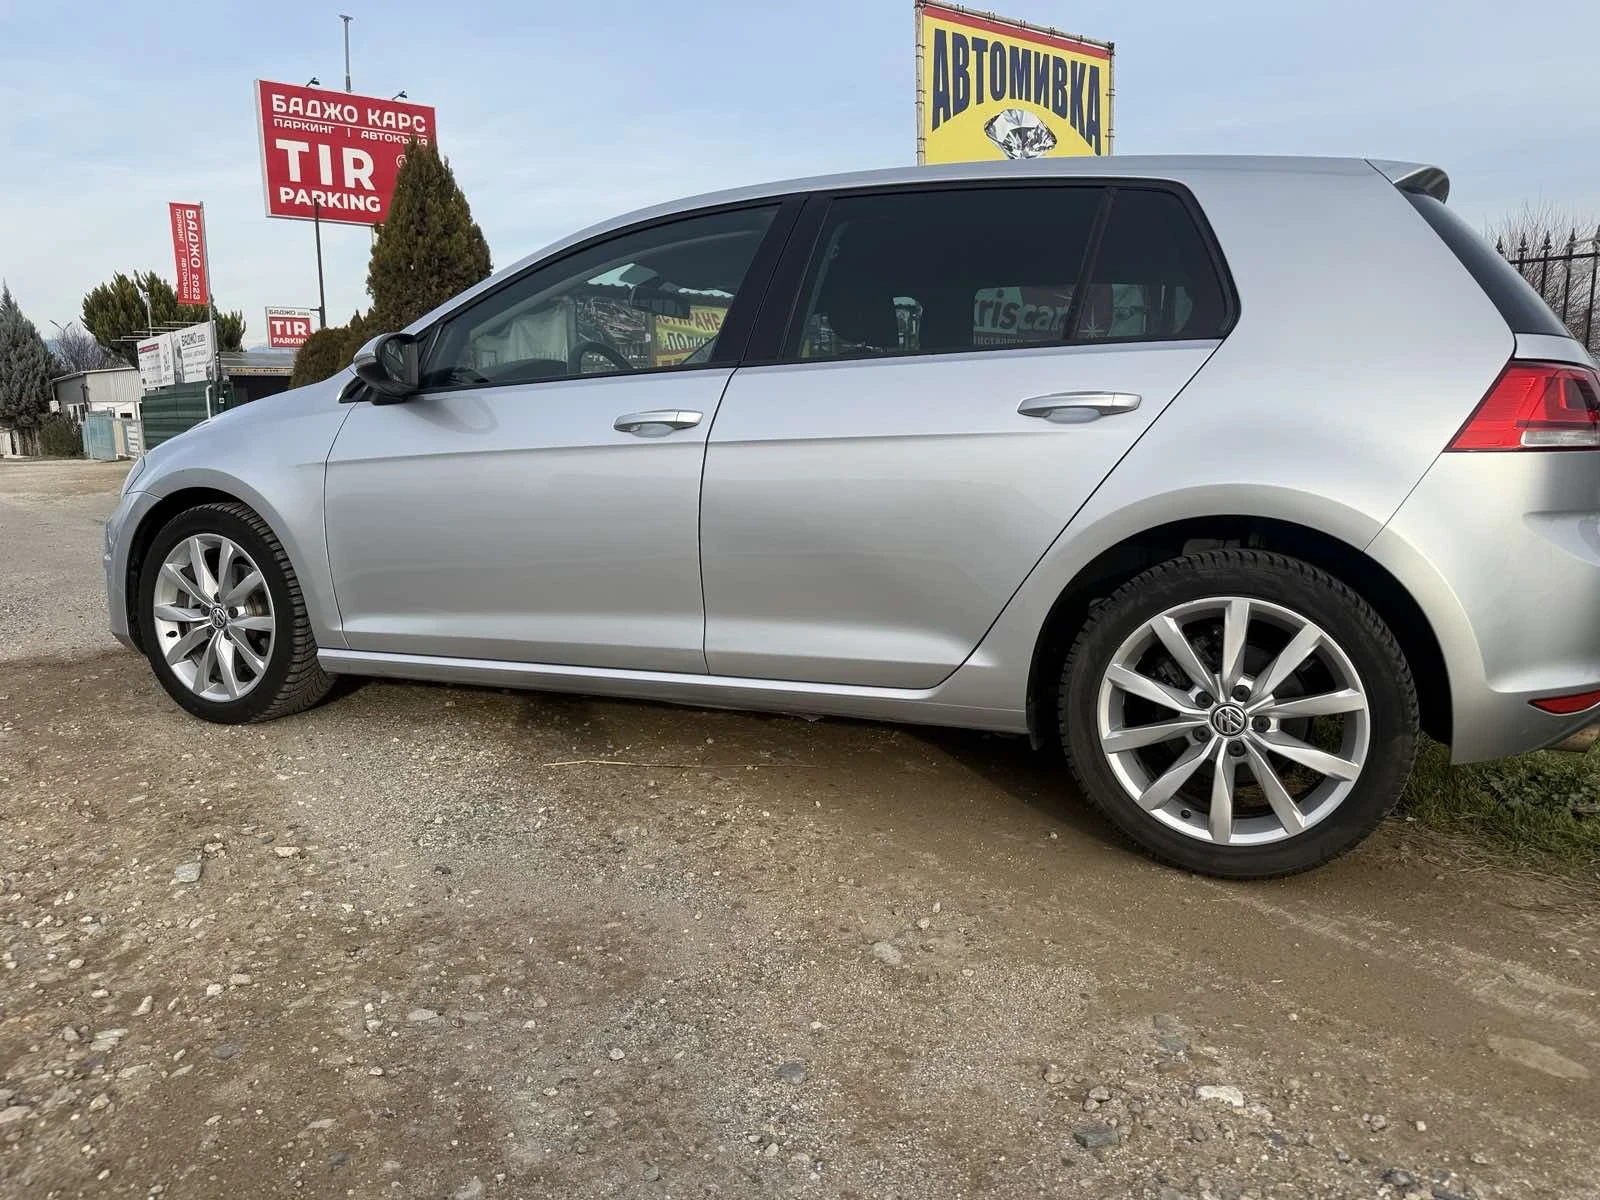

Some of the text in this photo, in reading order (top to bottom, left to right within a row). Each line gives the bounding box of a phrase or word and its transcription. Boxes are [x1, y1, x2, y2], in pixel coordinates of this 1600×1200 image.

[931, 28, 1101, 156] АВТОМИВКА
[271, 93, 427, 133] БАДЖО КАРС
[273, 118, 428, 147] ПАРКИНГ АВТОКЪА
[275, 138, 376, 191] TIR
[279, 186, 381, 213] PARKING
[175, 208, 184, 244] ПАРКИНГ
[185, 209, 201, 300] БАДЖО 2023
[271, 320, 307, 336] TIR
[273, 337, 307, 345] PARKIN
